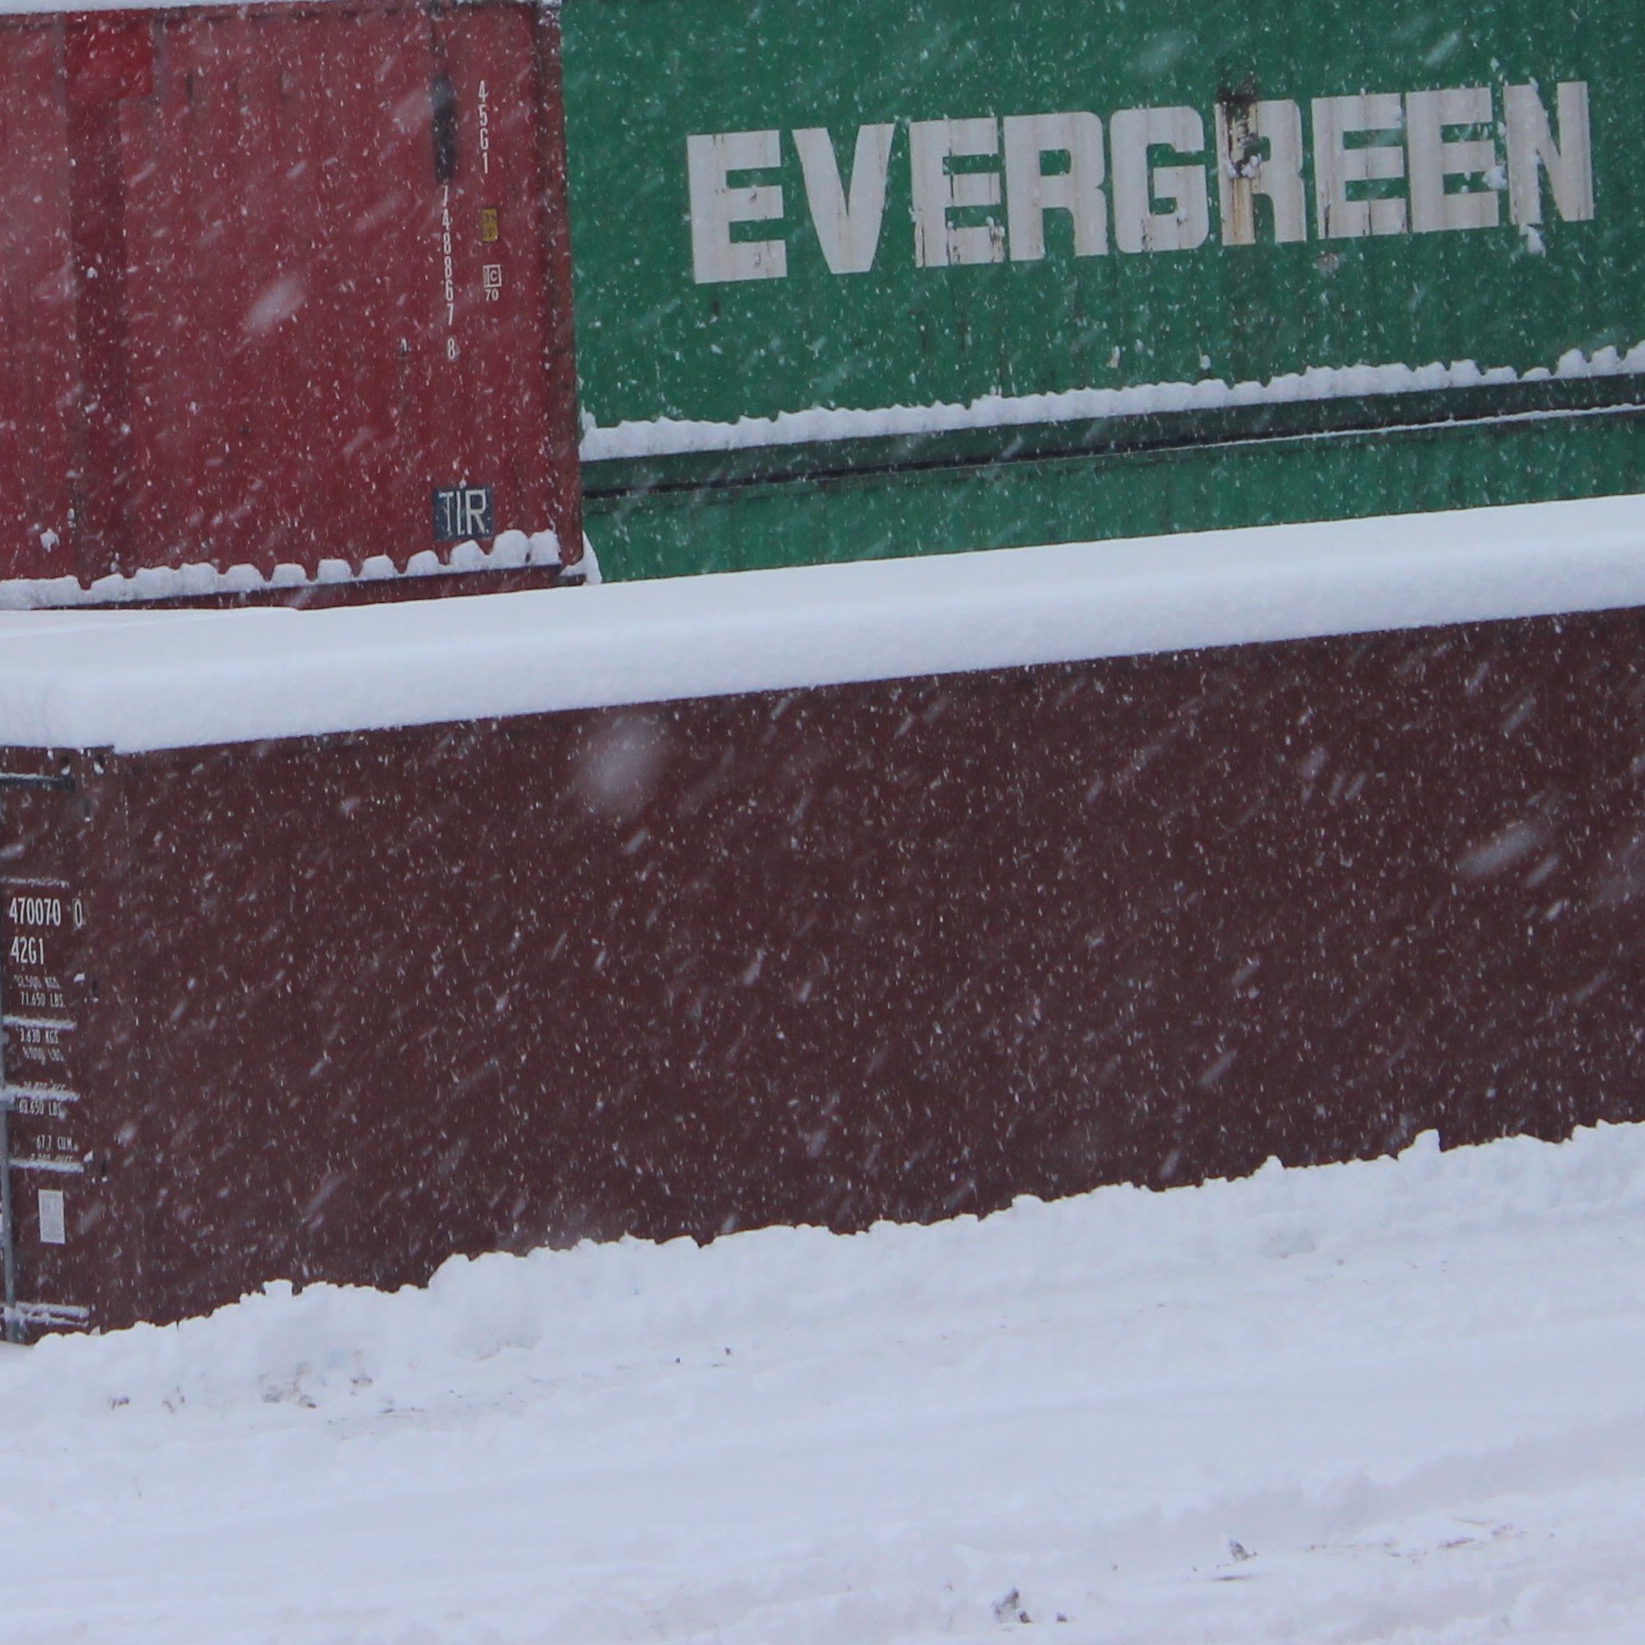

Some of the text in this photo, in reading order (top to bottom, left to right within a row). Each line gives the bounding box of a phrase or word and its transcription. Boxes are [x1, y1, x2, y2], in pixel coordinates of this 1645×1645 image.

[687, 82, 1595, 285] EVERGREEN
[438, 488, 490, 536] TIR
[9, 897, 62, 927] 470070
[11, 937, 45, 965] 42G1
